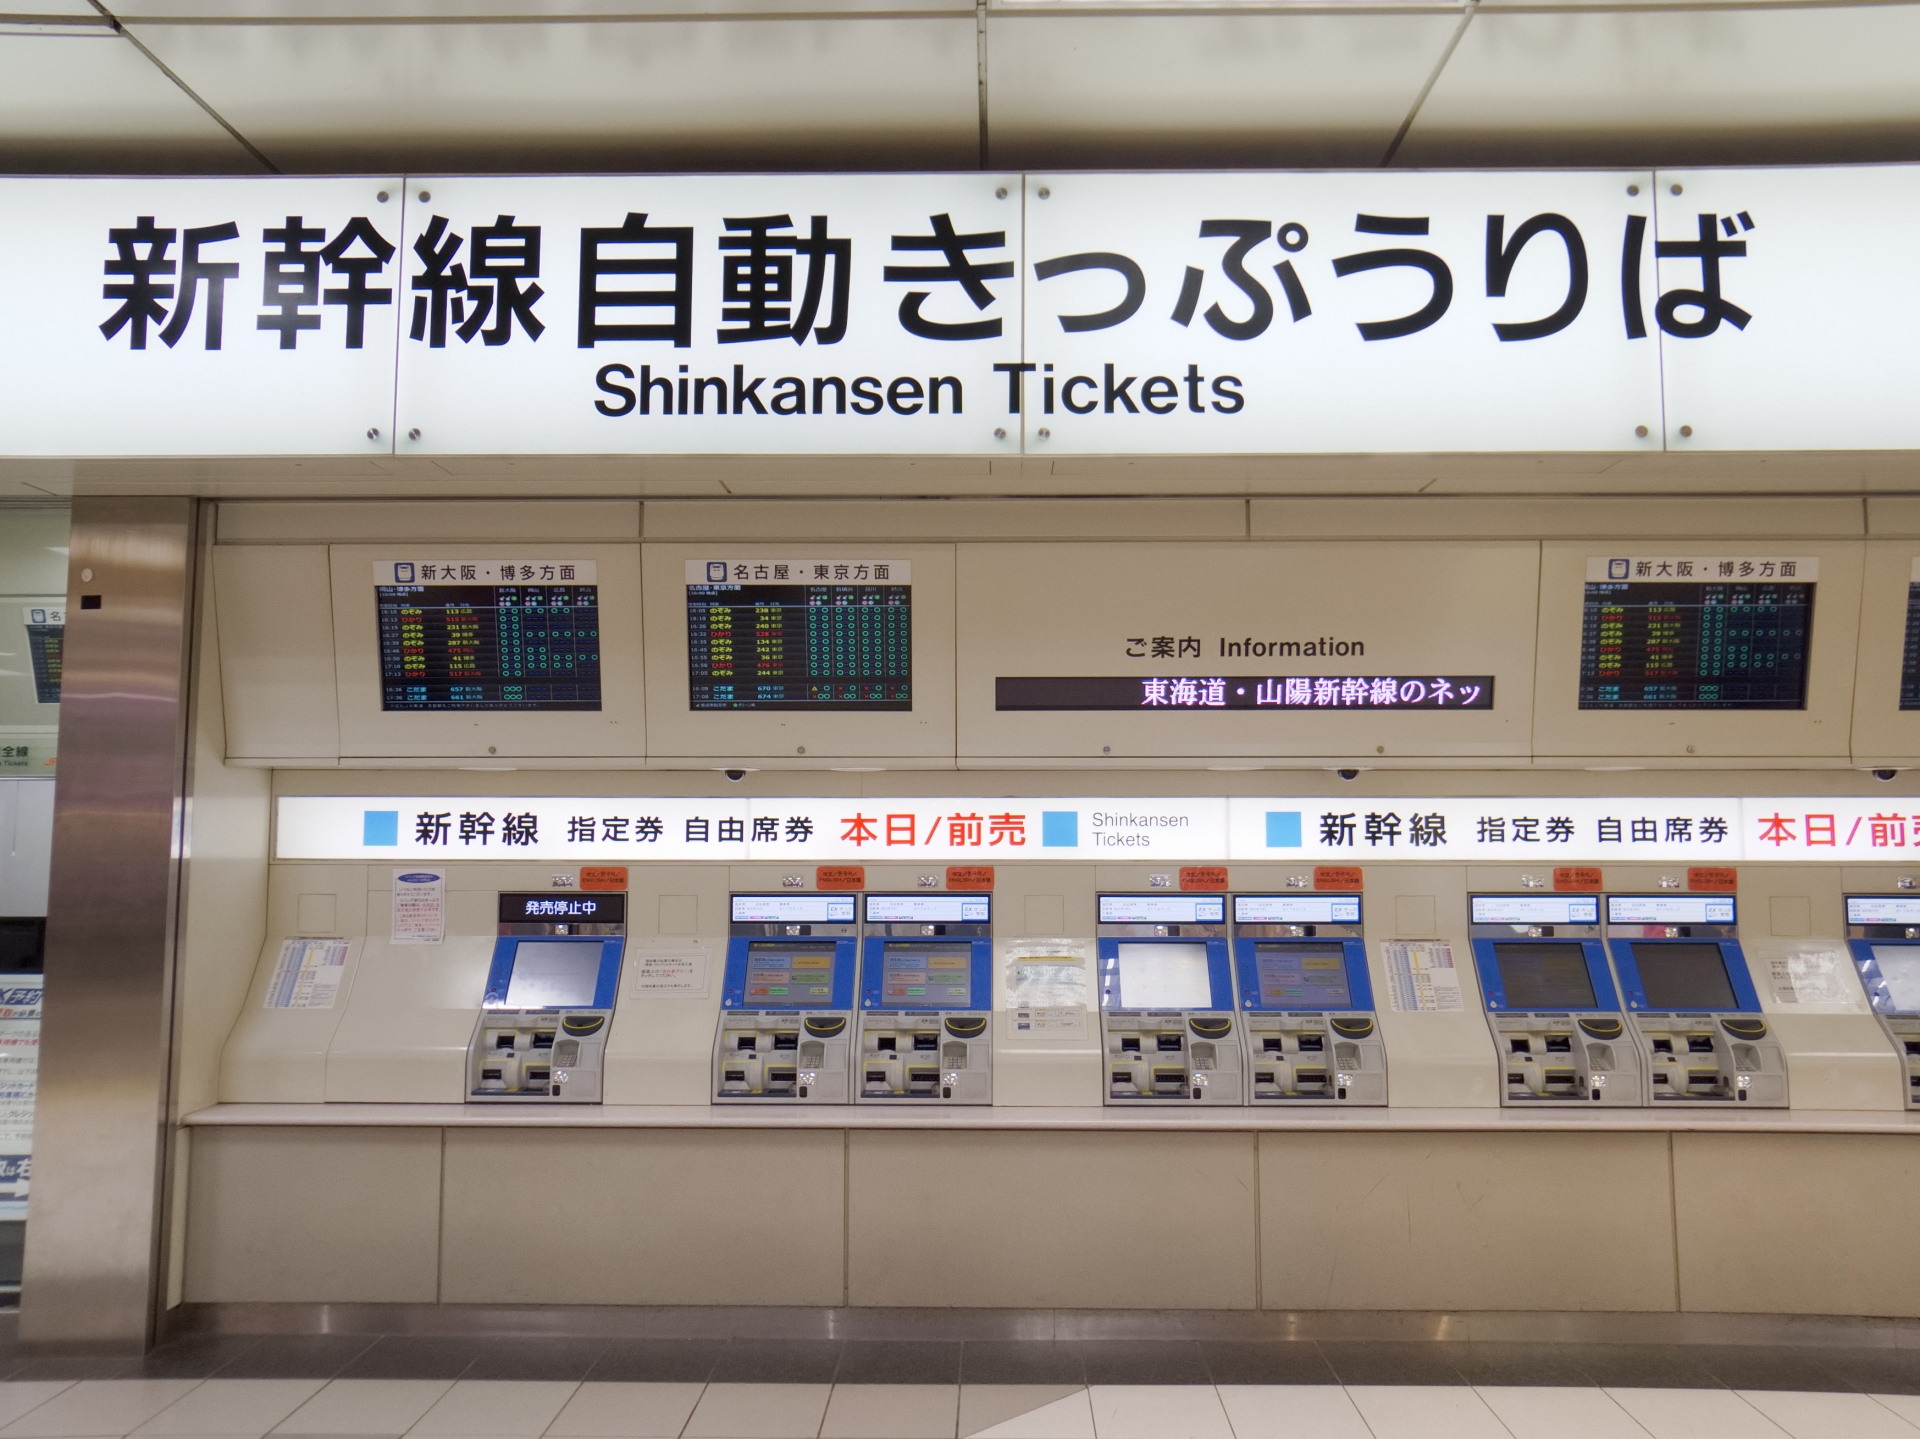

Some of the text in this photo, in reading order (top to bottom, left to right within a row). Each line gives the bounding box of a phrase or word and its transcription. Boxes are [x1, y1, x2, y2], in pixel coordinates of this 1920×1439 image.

[99, 211, 1755, 350] 新幹線自動きっぷうりば
[594, 363, 1244, 417] Shinkansen Tickets
[421, 565, 575, 581] 新大阪・博多方面
[734, 564, 890, 580] 名古屋・東京方面
[1636, 561, 1797, 578] 新大阪・博多方面
[1126, 636, 1365, 658] ご案内 Information
[1142, 678, 1481, 706] 東海道・山陽新幹線のネッ
[415, 812, 1025, 846] 新幹線 指定券 自由席券 本日/前売
[1093, 813, 1189, 827] Shinkansen
[1320, 812, 1447, 846] 新幹線
[1477, 817, 1574, 843] 指定券
[1598, 817, 1728, 843] 自由席券
[1094, 833, 1150, 846] Tickets
[525, 901, 597, 916] 発売停止中
